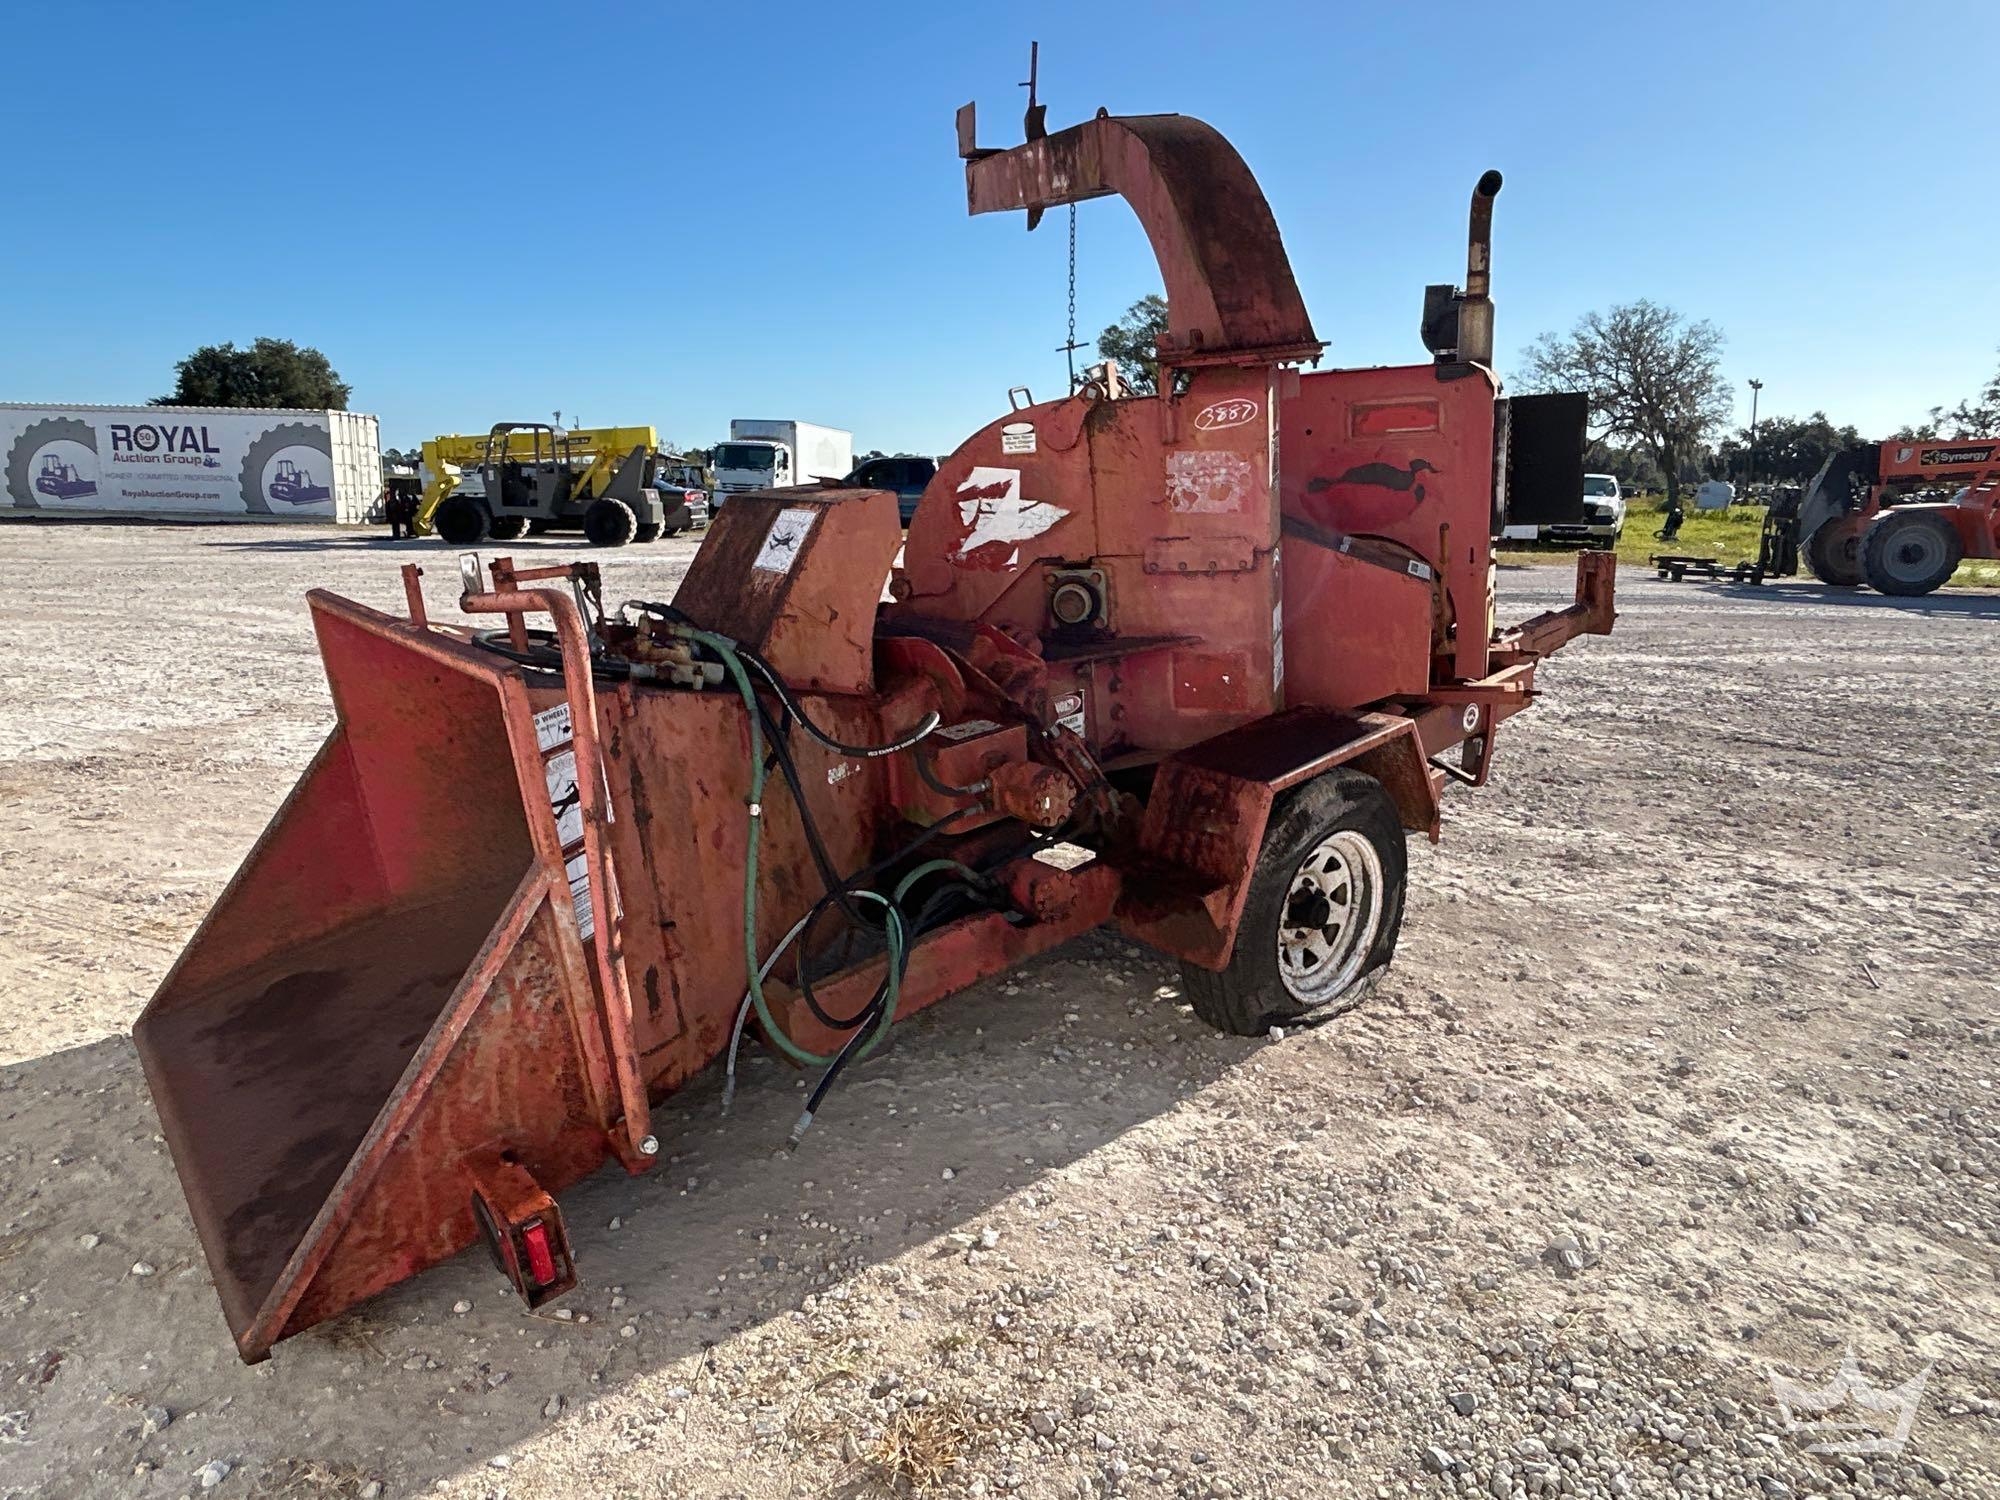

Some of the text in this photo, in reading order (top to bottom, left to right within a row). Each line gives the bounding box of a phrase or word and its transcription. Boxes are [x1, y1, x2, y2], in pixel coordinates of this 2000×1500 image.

[1200, 404, 1252, 428] 3887
[110, 424, 220, 453] ROYAL
[113, 452, 202, 466] Auction Group
[1940, 452, 1988, 463] Synergy
[121, 489, 221, 500] RoyalAuctionGroup.com
[542, 707, 569, 724] WHEELS
